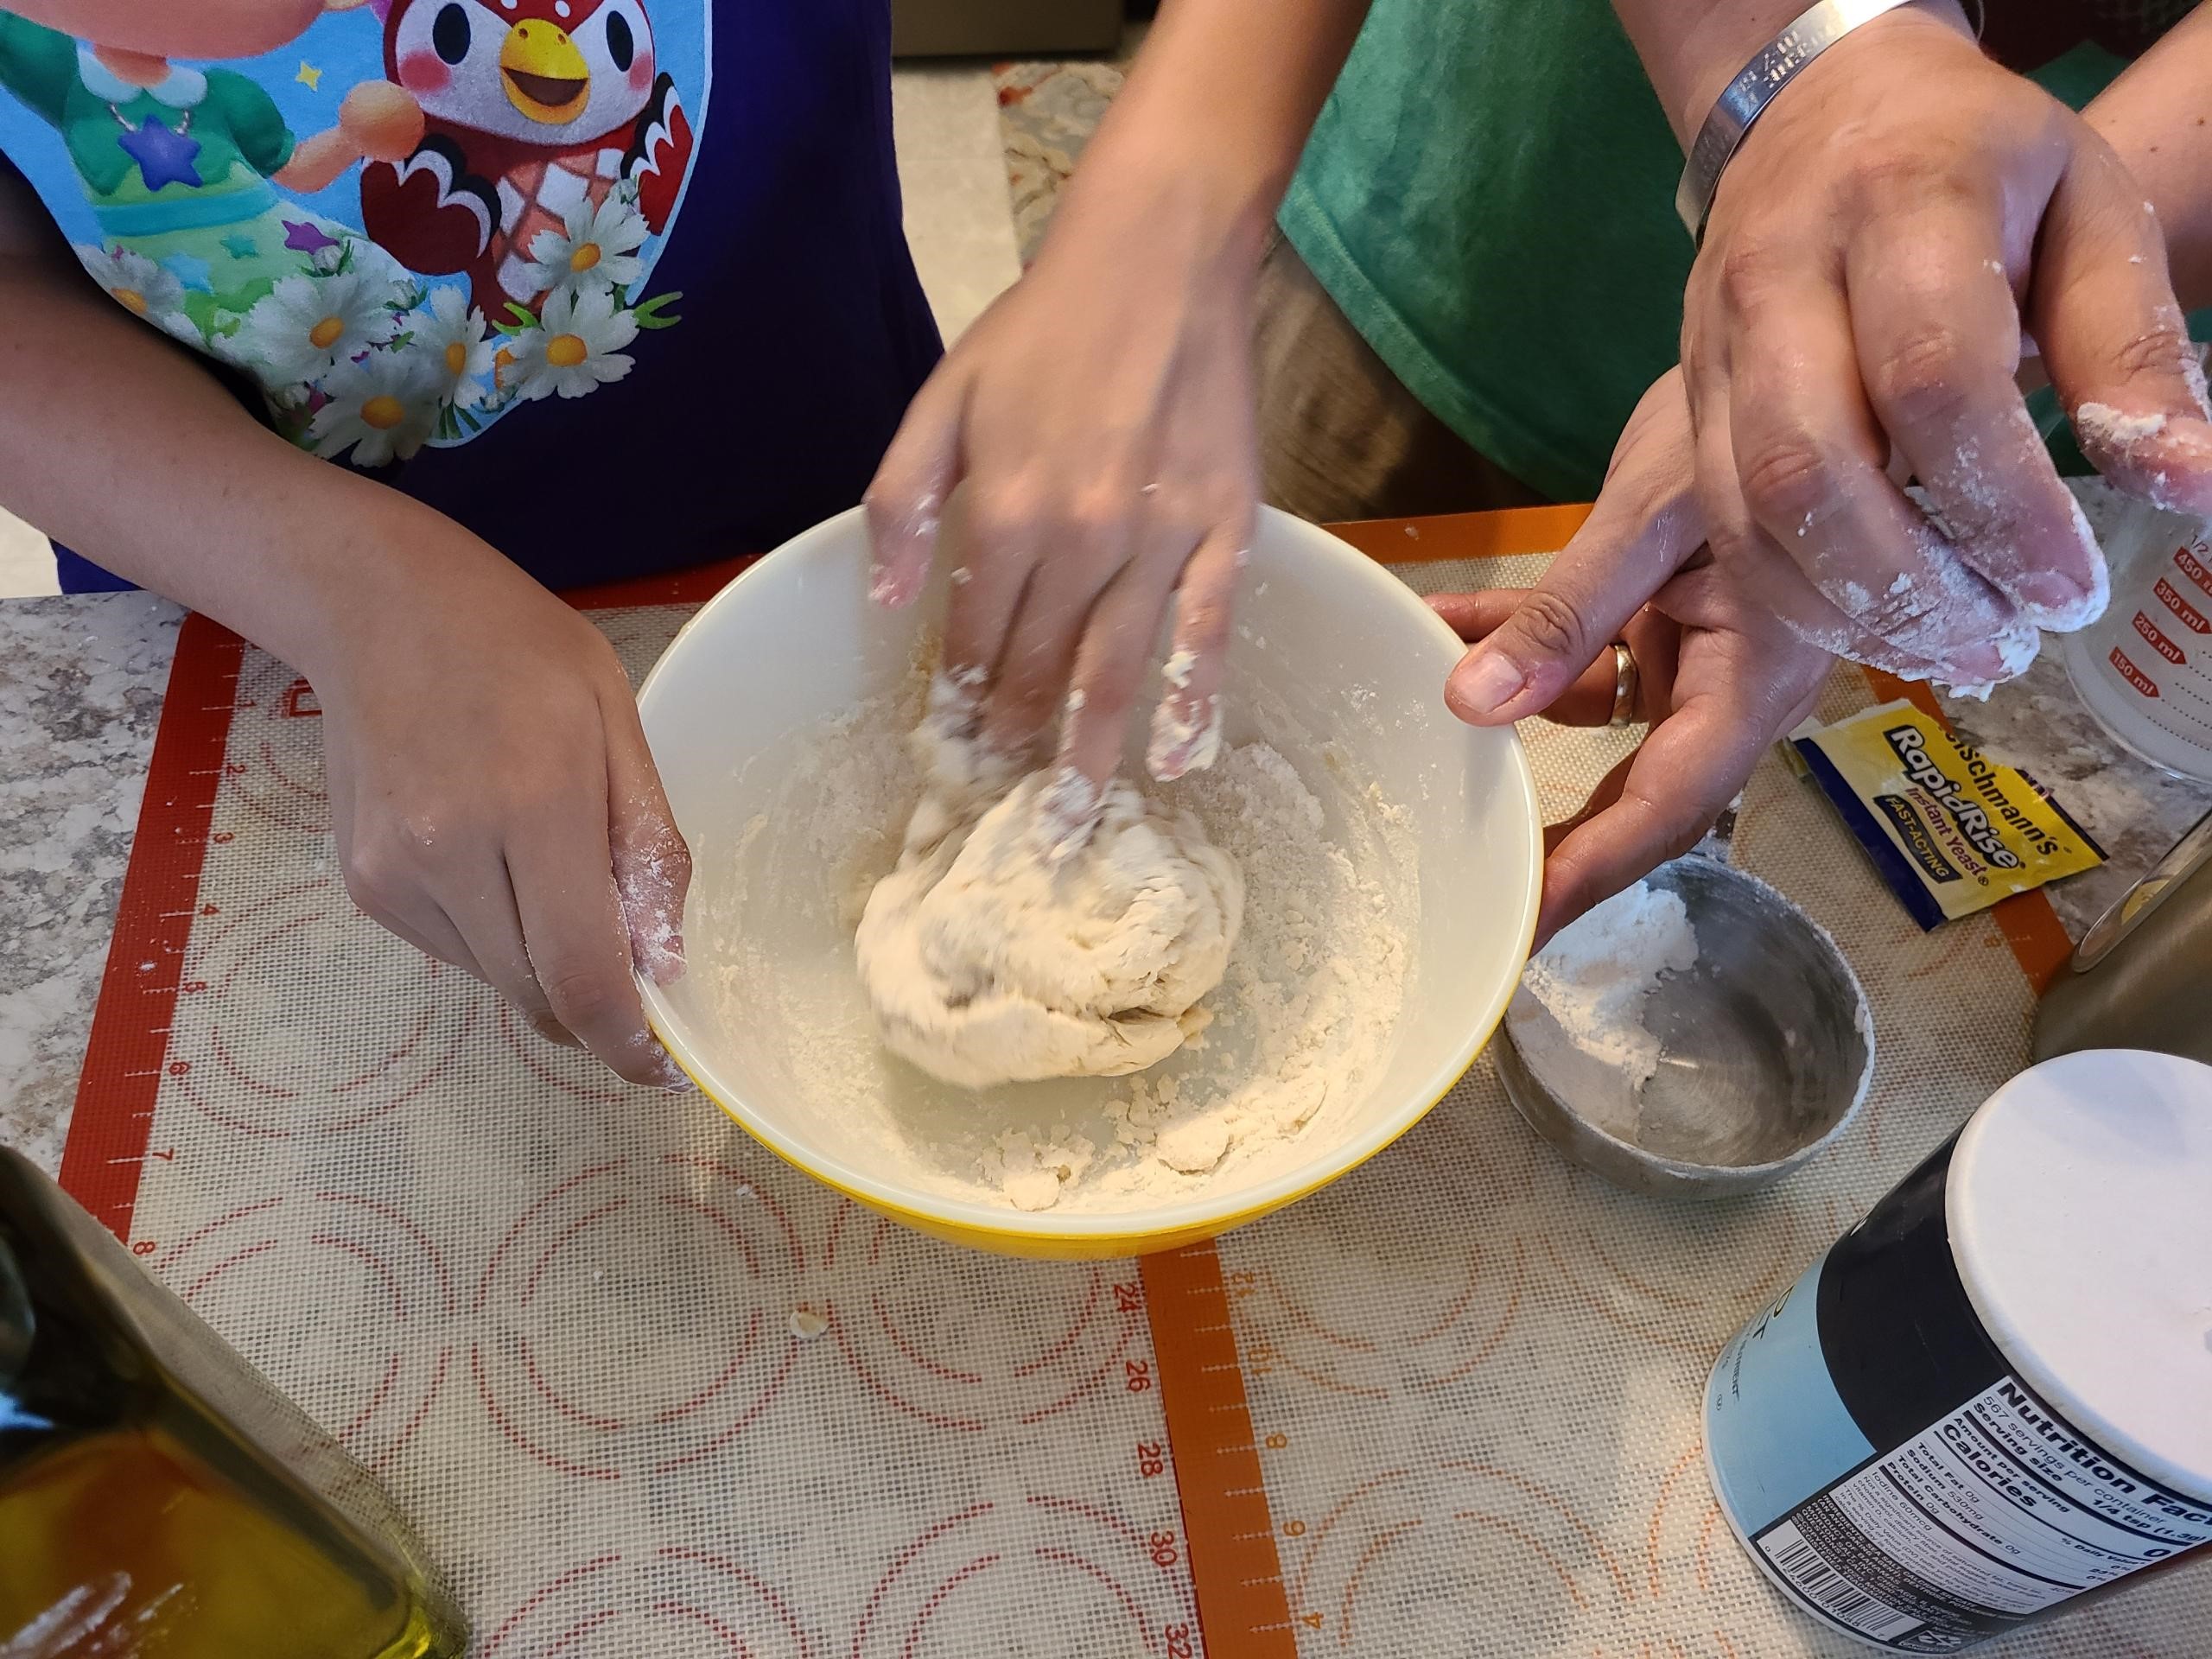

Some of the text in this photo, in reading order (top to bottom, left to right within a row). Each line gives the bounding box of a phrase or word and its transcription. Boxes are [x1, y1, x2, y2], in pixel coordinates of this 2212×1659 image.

[2177, 553, 2203, 580] 450
[2156, 582, 2205, 632] 350 ml
[2134, 615, 2180, 662] 250 ml
[2113, 653, 2155, 695] 150 ml
[226, 764, 246, 776] 2
[1889, 726, 2019, 868] RapidRise
[1937, 726, 2059, 855] ischmann's
[213, 831, 236, 845] 3
[1884, 797, 1949, 878] FAST-ACTING
[1905, 786, 1988, 876] Instant Yeast
[200, 904, 221, 917] 4
[182, 981, 207, 993] 5
[168, 1061, 191, 1075] 6
[152, 1148, 174, 1160] 7
[132, 1241, 156, 1255] 8
[1114, 1282, 1141, 1313] 24
[1231, 1271, 1256, 1298] 12
[1126, 1359, 1151, 1393] 26
[1248, 1348, 1273, 1376] 10
[1265, 1433, 1288, 1450] 8
[1997, 1382, 2137, 1494] Nutrition
[1137, 1442, 1164, 1478] 28
[1915, 1441, 1944, 1471] Total
[1942, 1471, 1966, 1490] Fat
[1962, 1490, 1981, 1503] 0g
[1952, 1415, 2072, 1513] Amount per serving
[1970, 1401, 2208, 1541] Serving size 1/4 tsp (1.3g)
[1981, 1394, 2169, 1524] 567 servings per container
[1870, 1471, 1901, 1501] Iodine
[1896, 1500, 1935, 1531] 60mcg
[1885, 1460, 1942, 1515] Protein 0g
[1895, 1454, 1924, 1483] Total
[1921, 1484, 2005, 1545] Carbohydrate
[2002, 1544, 2023, 1554] 0g
[1905, 1448, 1948, 1490] Sodium
[1945, 1490, 1986, 1521] 530mg
[1940, 1421, 2171, 1558] Calories 0
[1804, 1504, 1838, 1541] MORTON
[1832, 1495, 1860, 1523] calories
[1849, 1482, 1877, 1509] vitamin
[1881, 1516, 1915, 1544] calcium,
[1849, 1505, 1877, 1531] serving
[1855, 1478, 1896, 1519] cholesterol,
[1891, 1518, 1921, 1541] dietary
[1861, 1475, 1877, 1490] Not
[1878, 1495, 1917, 1529] significant
[1914, 1529, 1943, 1549] source
[1862, 1511, 1884, 1529] Daily
[1150, 1530, 1178, 1568] 30
[1799, 1508, 1847, 1558] QUESTIONS?
[1844, 1558, 1866, 1575] CALL
[1810, 1502, 1902, 1586] PRODUCT OF BAHAMAS
[1821, 1494, 1867, 1542] INGREDIENTS:
[1864, 1541, 1883, 1556] SEA
[1901, 1570, 1941, 1592] CALCIUM
[1827, 1511, 1873, 1556] ANTI-CAKING
[2072, 1543, 2107, 1557] Daily
[1840, 1570, 1896, 1607] TRADEMARK
[1863, 1581, 1904, 1606] MORTON
[1301, 1611, 1325, 1630] 4
[1165, 1623, 1193, 1659] 32
